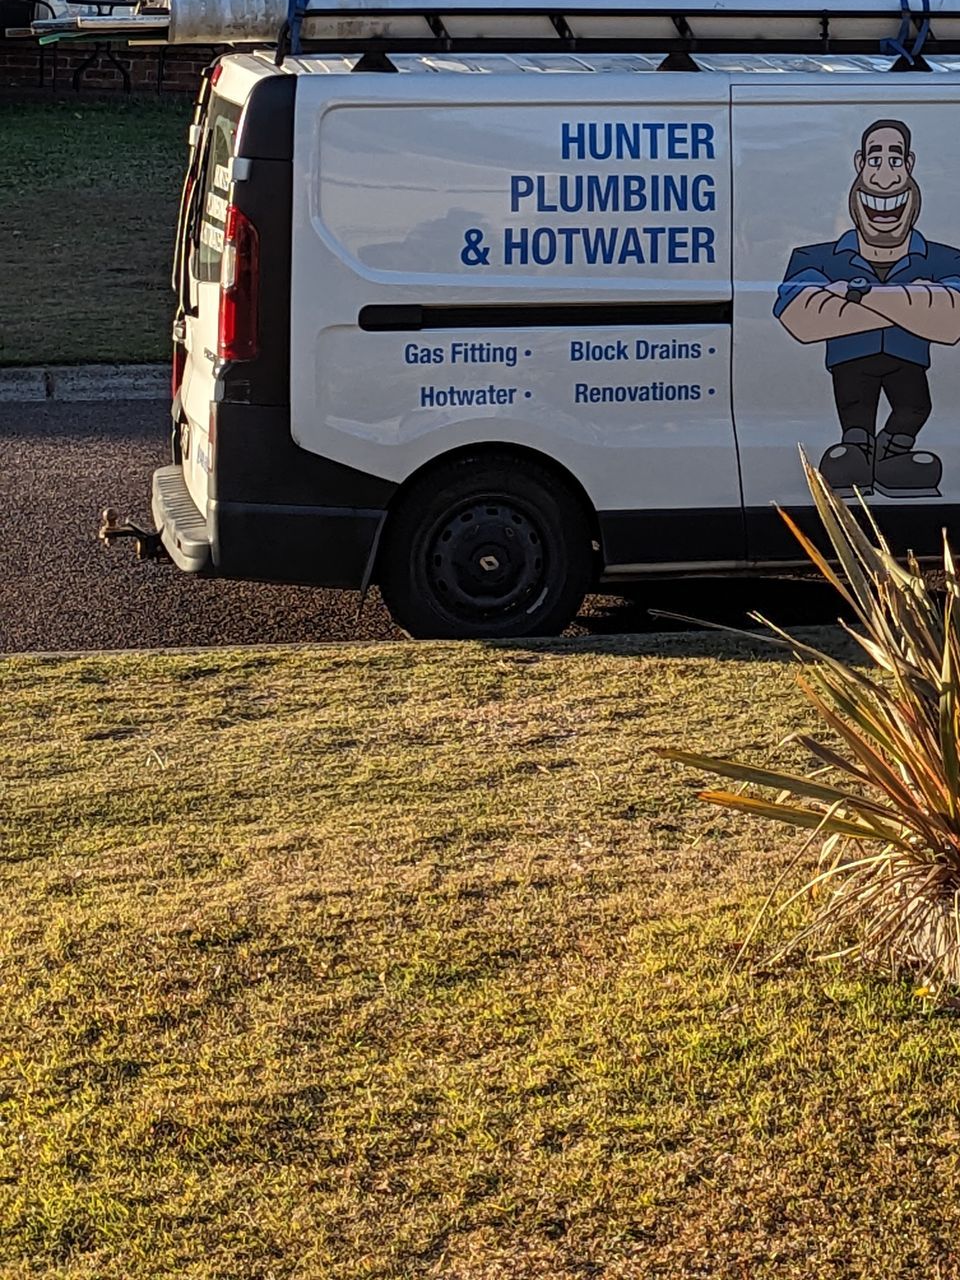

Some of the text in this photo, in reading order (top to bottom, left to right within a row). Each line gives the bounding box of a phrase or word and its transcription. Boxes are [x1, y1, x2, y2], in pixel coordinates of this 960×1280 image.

[561, 123, 716, 160] HUNTER
[510, 175, 716, 213] PLUMBING
[460, 227, 716, 266] & HOTWATER
[405, 342, 518, 367] Gas Fitting
[570, 339, 702, 361] Block Drains
[420, 384, 517, 407] Hotwater
[575, 382, 702, 403] Renovations
